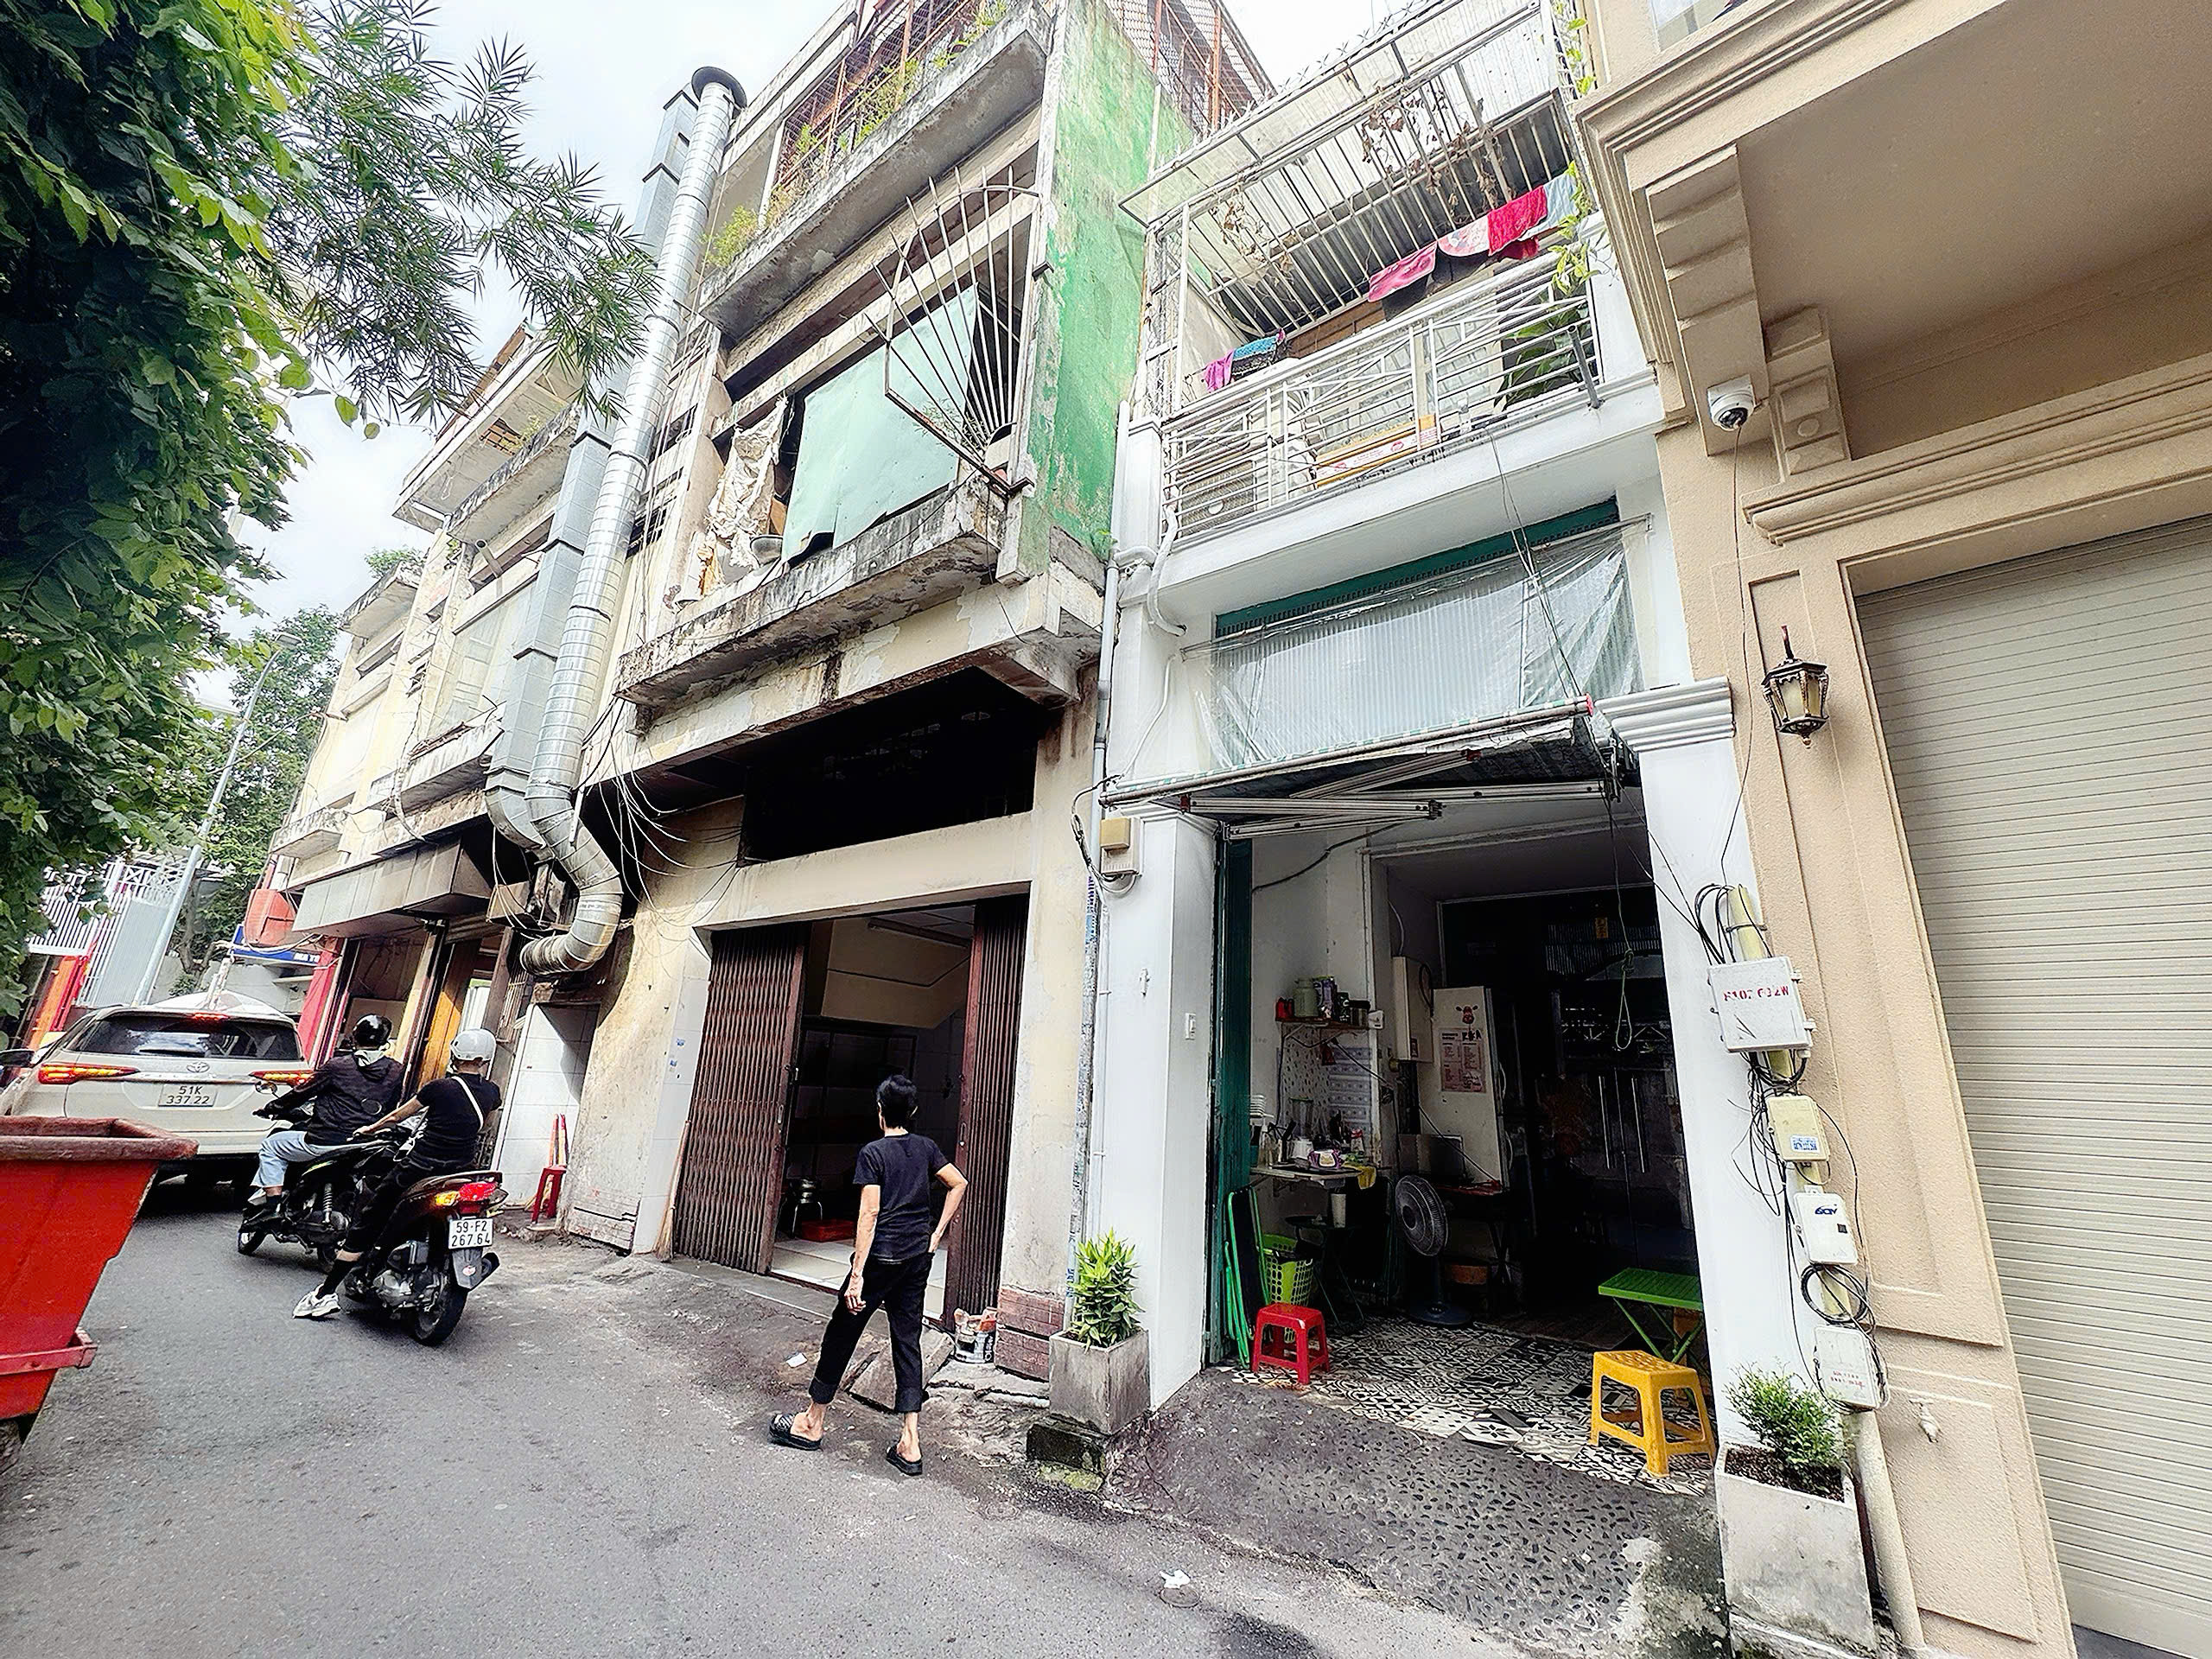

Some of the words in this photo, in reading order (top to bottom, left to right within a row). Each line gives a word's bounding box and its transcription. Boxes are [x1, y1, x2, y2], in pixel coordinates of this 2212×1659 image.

[178, 1085, 203, 1095] 51K
[166, 1095, 210, 1104] 337.22
[451, 1233, 491, 1246] 267.64
